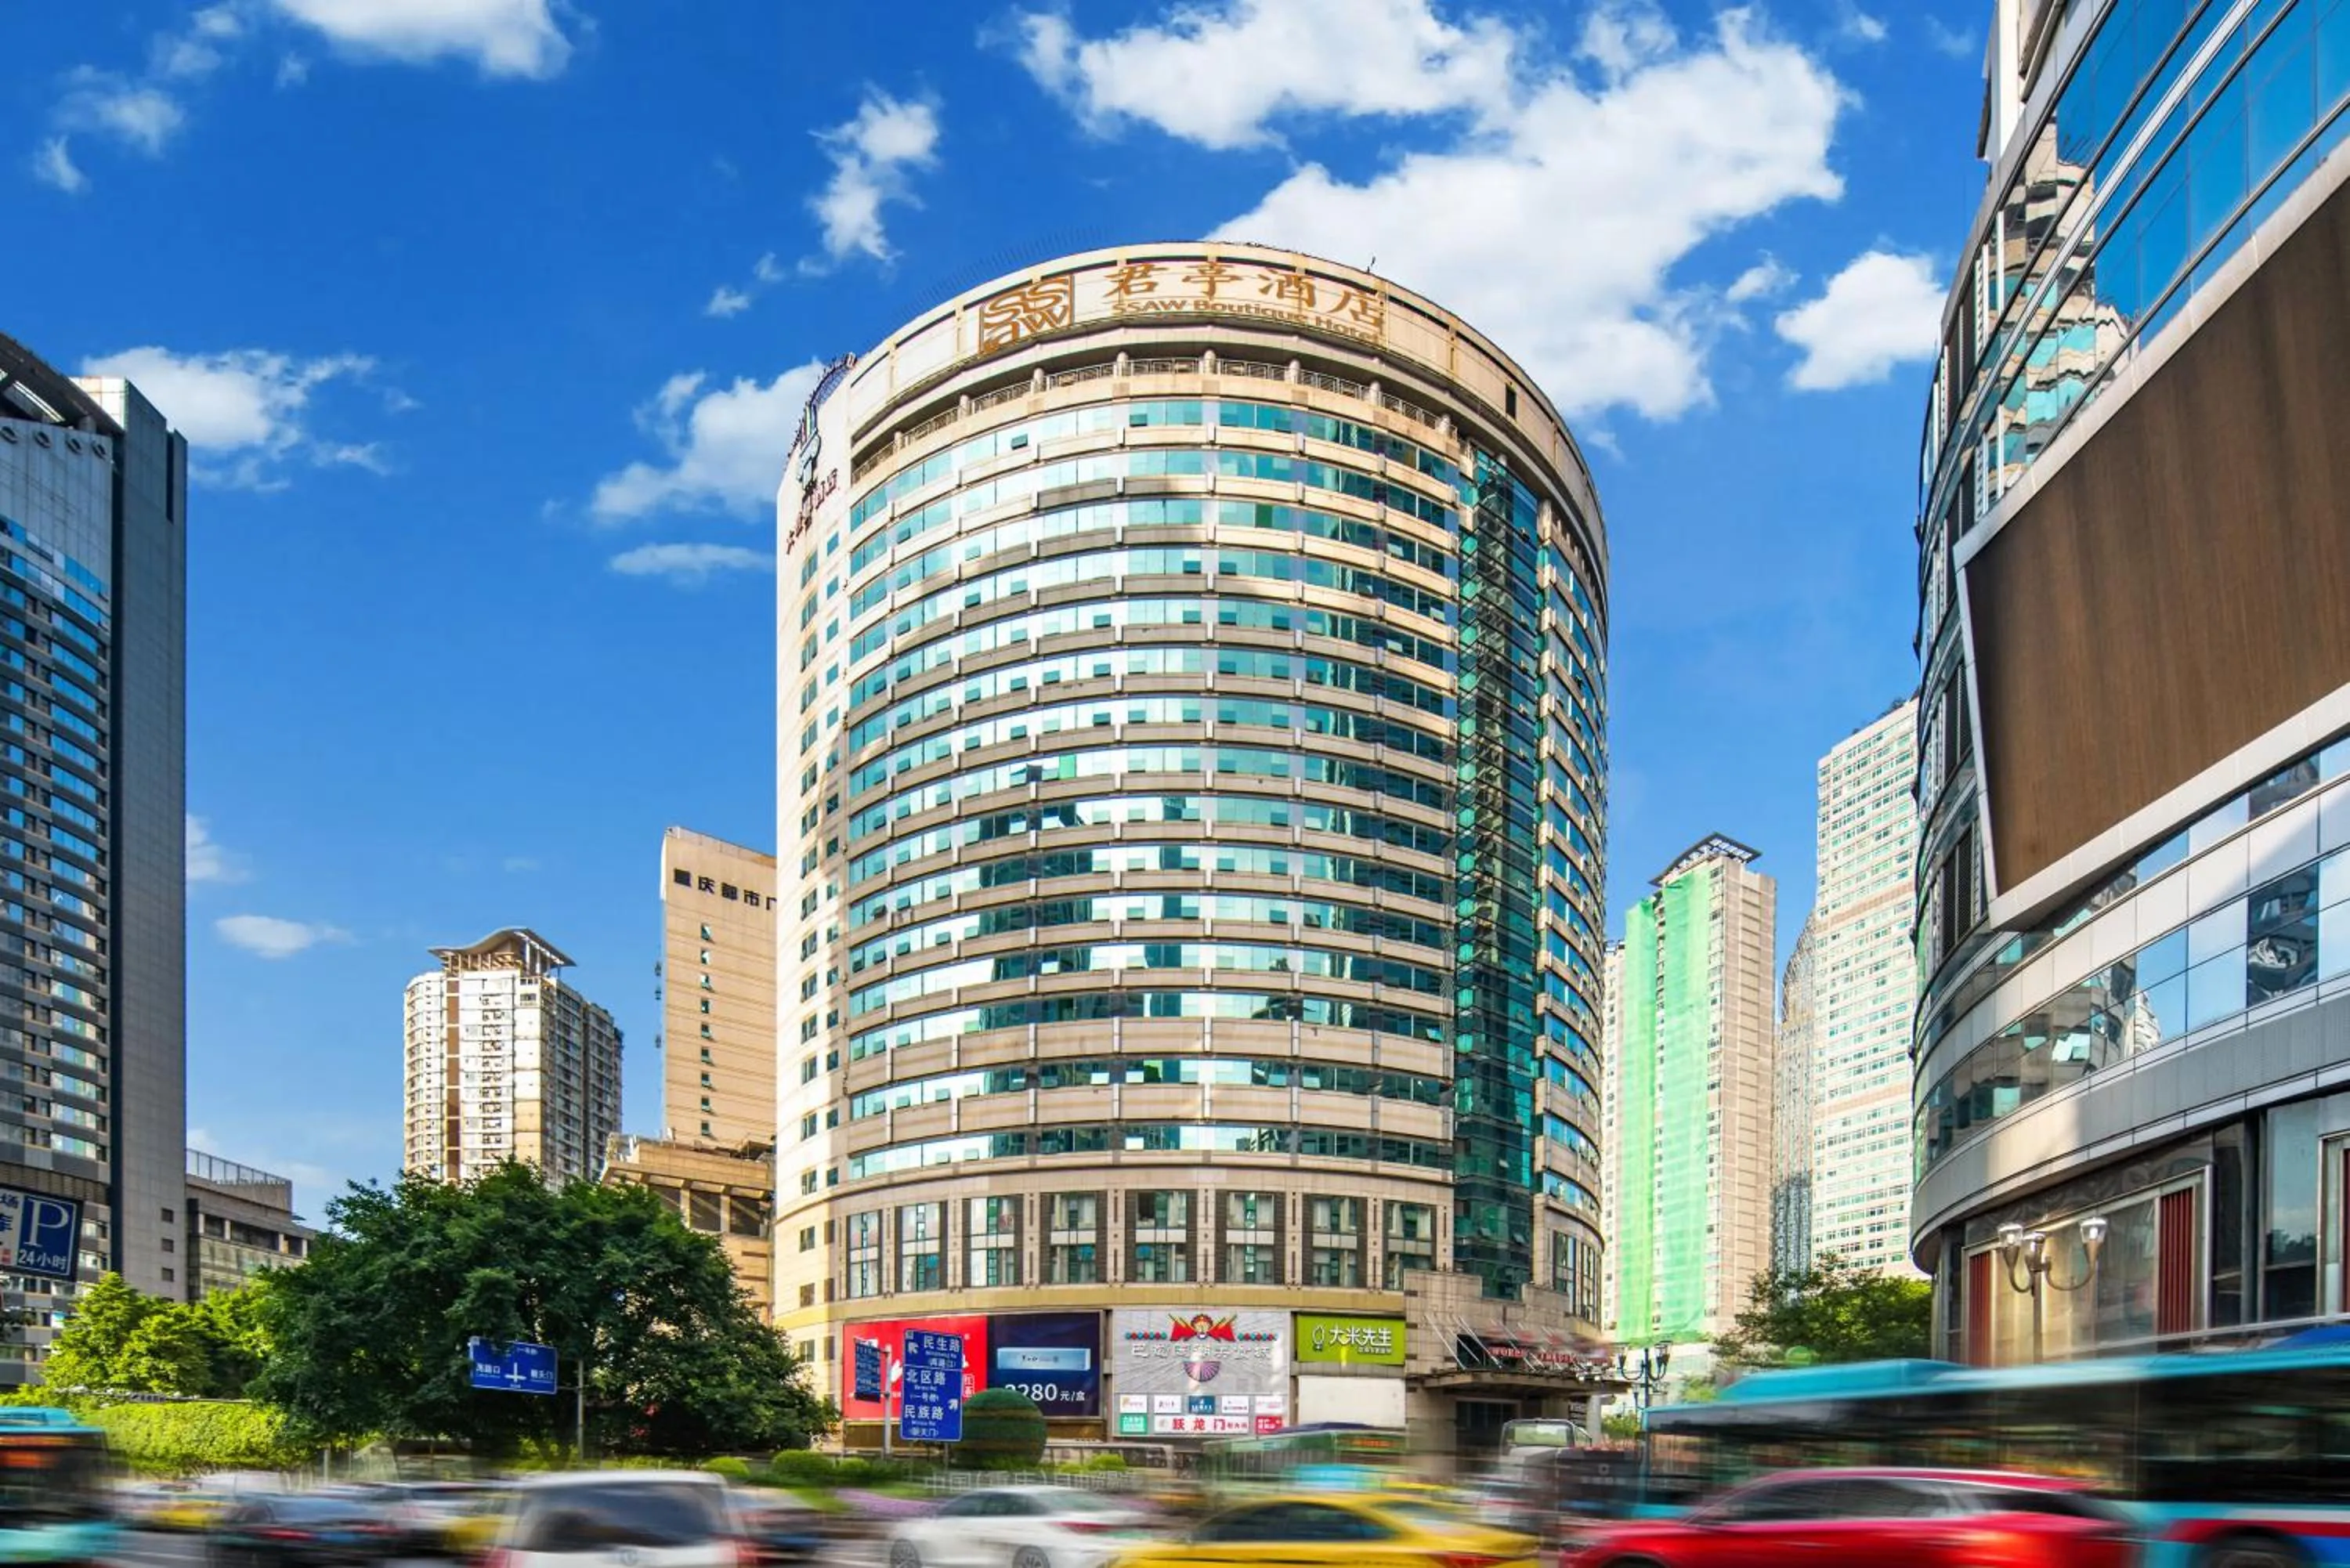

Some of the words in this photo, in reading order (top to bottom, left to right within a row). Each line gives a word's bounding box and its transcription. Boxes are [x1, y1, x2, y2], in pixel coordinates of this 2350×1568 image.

[1103, 261, 1386, 327] 君亭酒店
[1112, 299, 1187, 314] SSAW
[1194, 300, 1309, 322] Boutique
[24, 1198, 70, 1248] P
[18, 1248, 67, 1270] 24小时
[924, 1335, 960, 1353] 民生路
[1329, 1324, 1392, 1346] 大米先生
[906, 1368, 945, 1386] 北区路
[904, 1404, 944, 1421] 民族路
[1172, 1417, 1226, 1432] 跃龙门
